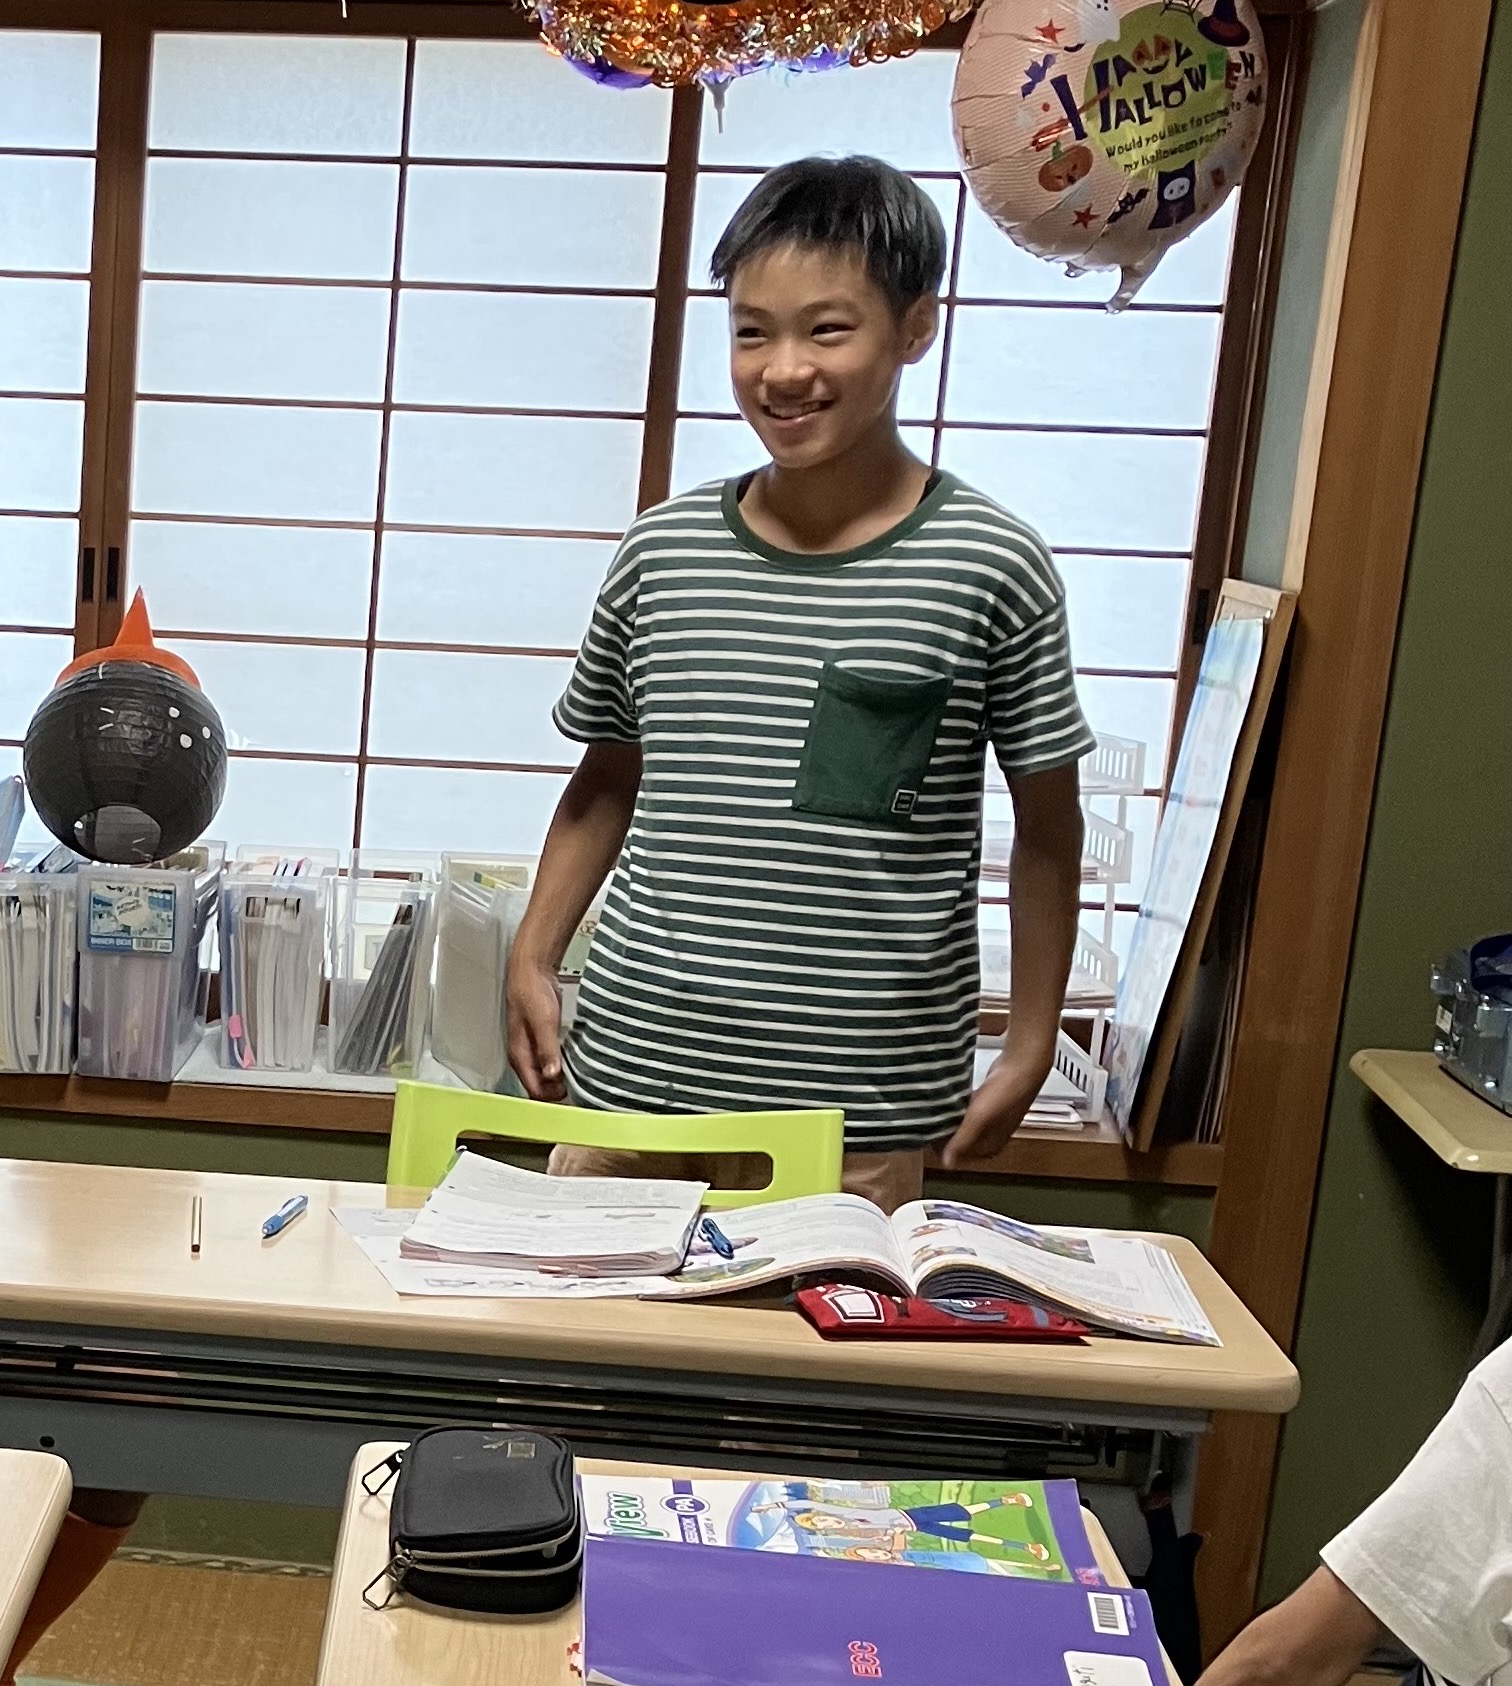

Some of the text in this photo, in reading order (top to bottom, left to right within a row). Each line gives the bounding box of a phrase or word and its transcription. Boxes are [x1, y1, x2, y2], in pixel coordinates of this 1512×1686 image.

[1106, 136, 1143, 158] Would
[1145, 129, 1167, 147] you
[1190, 116, 1203, 129] to
[675, 1497, 696, 1512] PA
[849, 1640, 884, 1679] ECC
